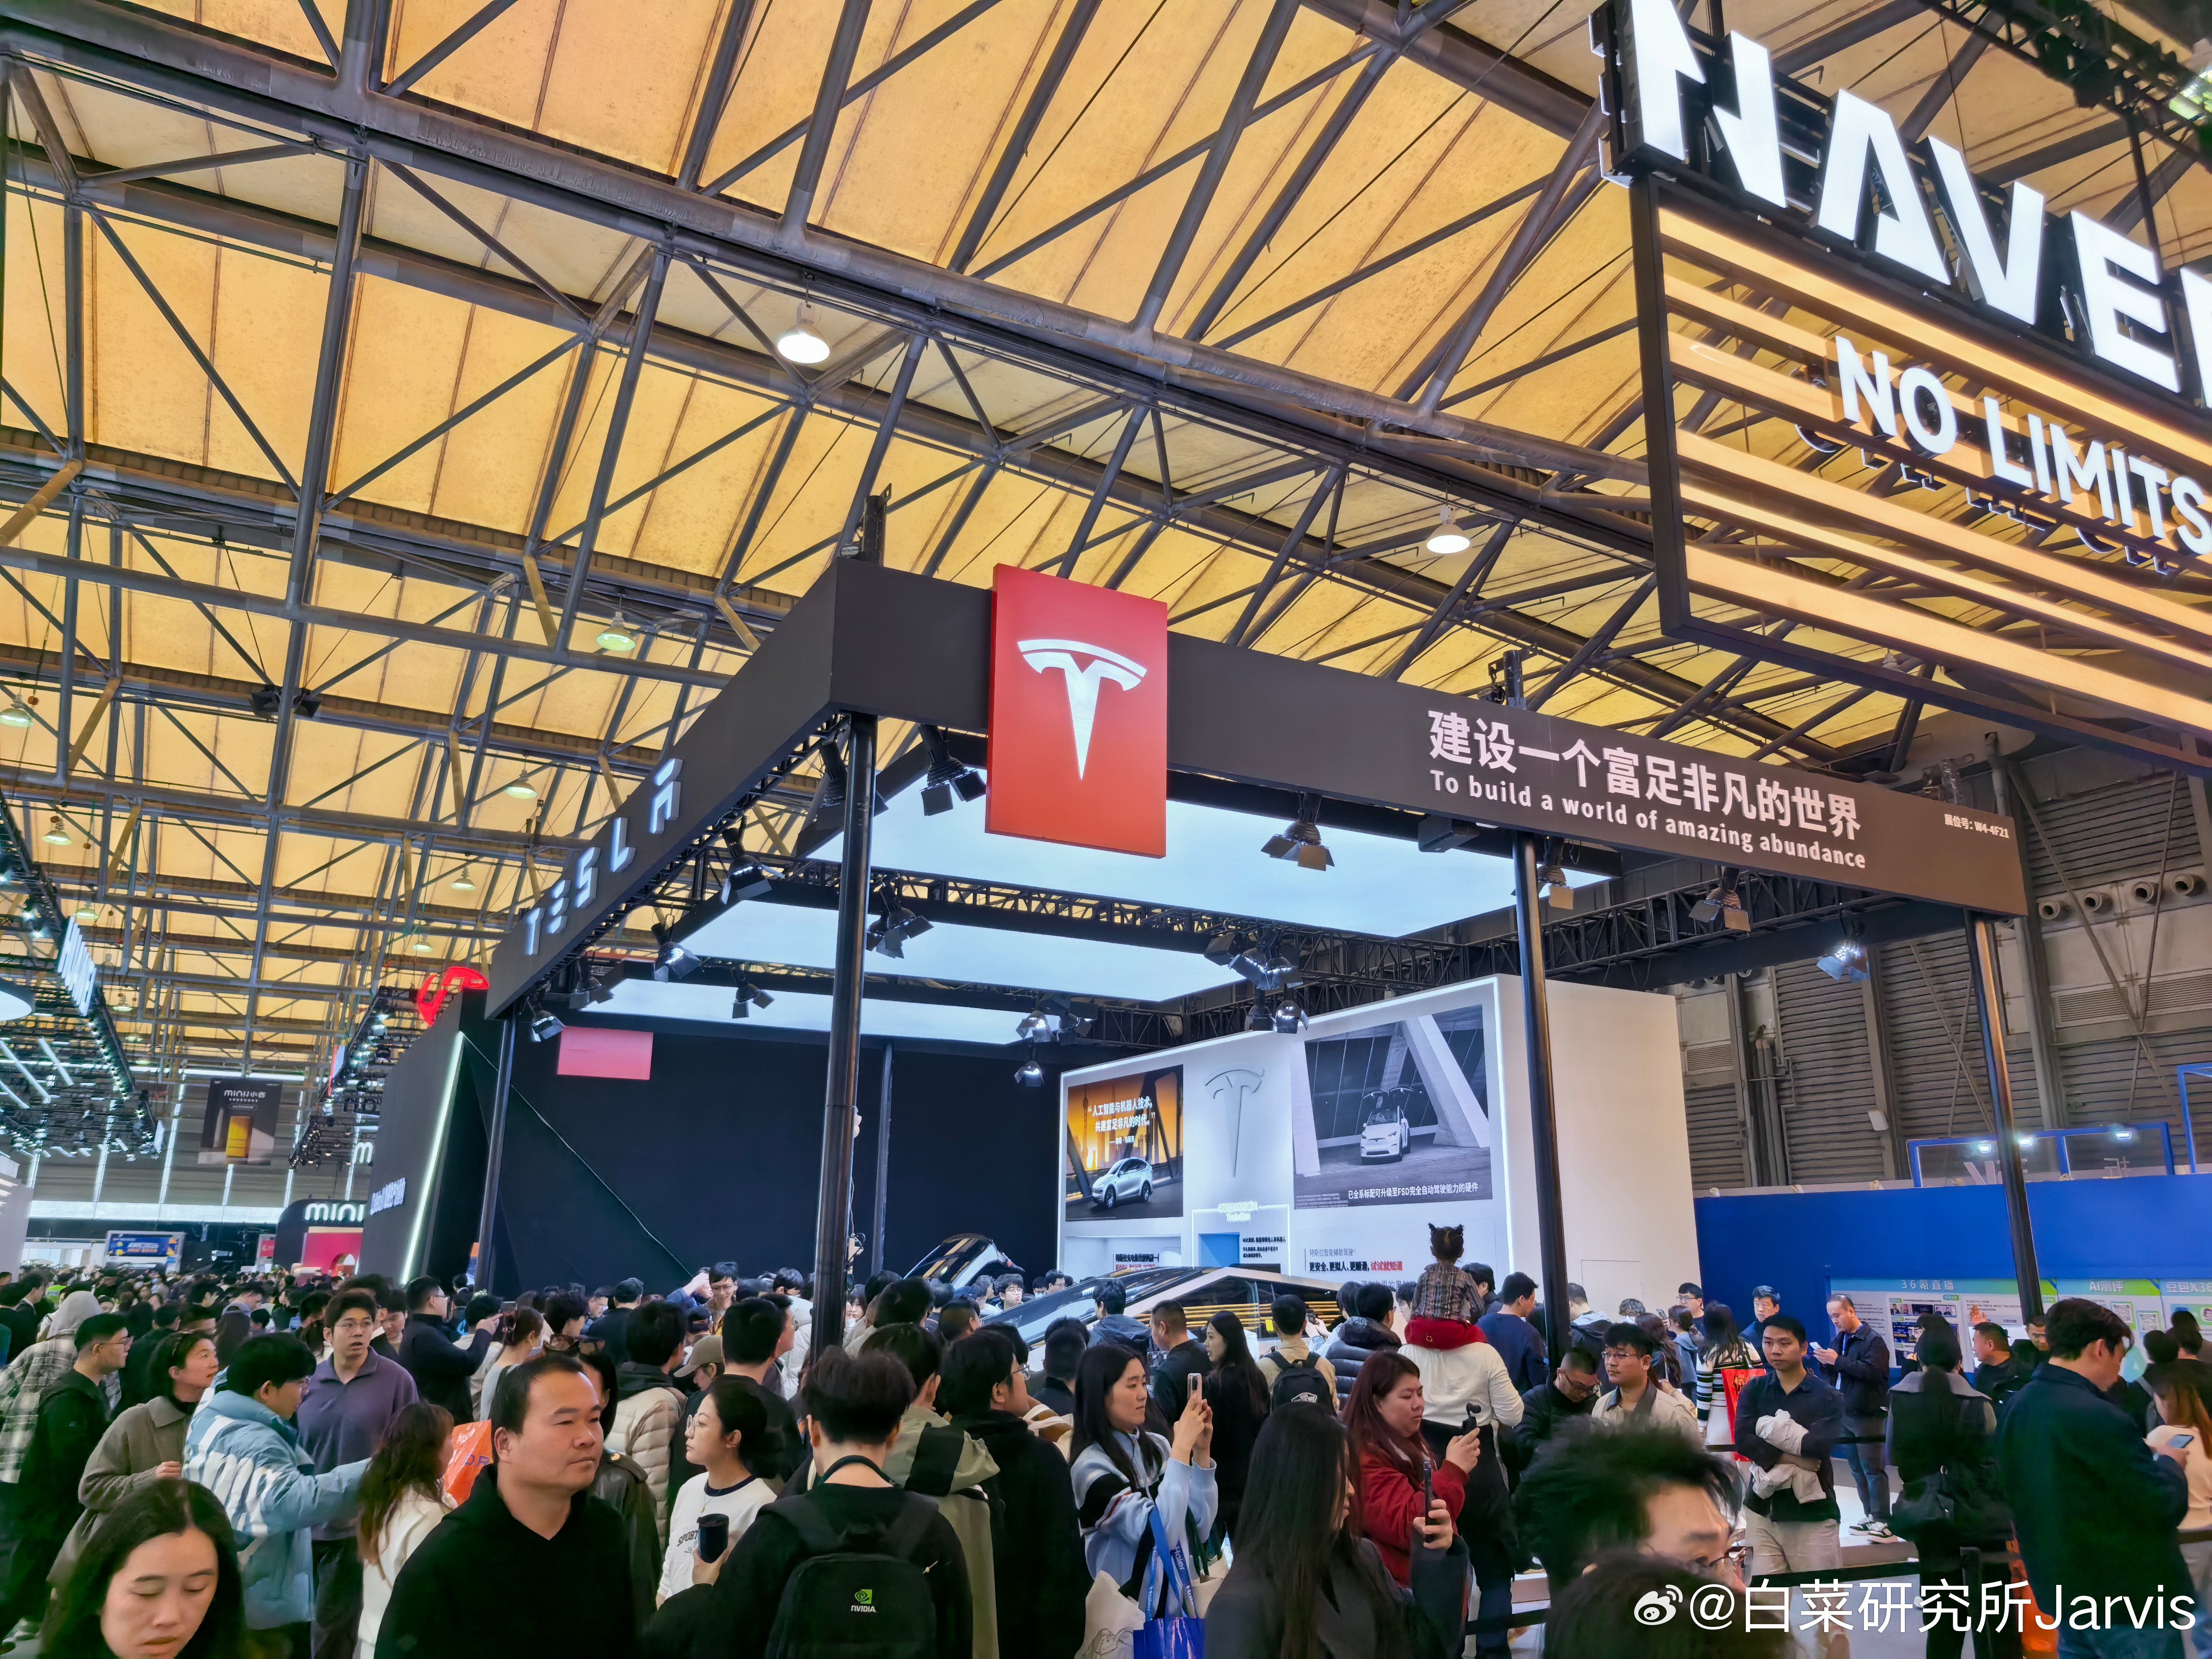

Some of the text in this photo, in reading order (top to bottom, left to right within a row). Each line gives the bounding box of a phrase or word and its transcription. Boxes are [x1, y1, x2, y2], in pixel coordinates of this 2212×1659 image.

[1631, 0, 2212, 409] NAVE
[1835, 336, 2212, 555] NO LIMITS
[526, 758, 683, 955] TESLA
[1427, 710, 1861, 840] 建设一个富足非凡的世界
[1430, 770, 1866, 868] To build a world of amazing abundance
[1348, 1182, 1479, 1199] 已全系标配可升级至FSD完全自动驾驶能力的硬件
